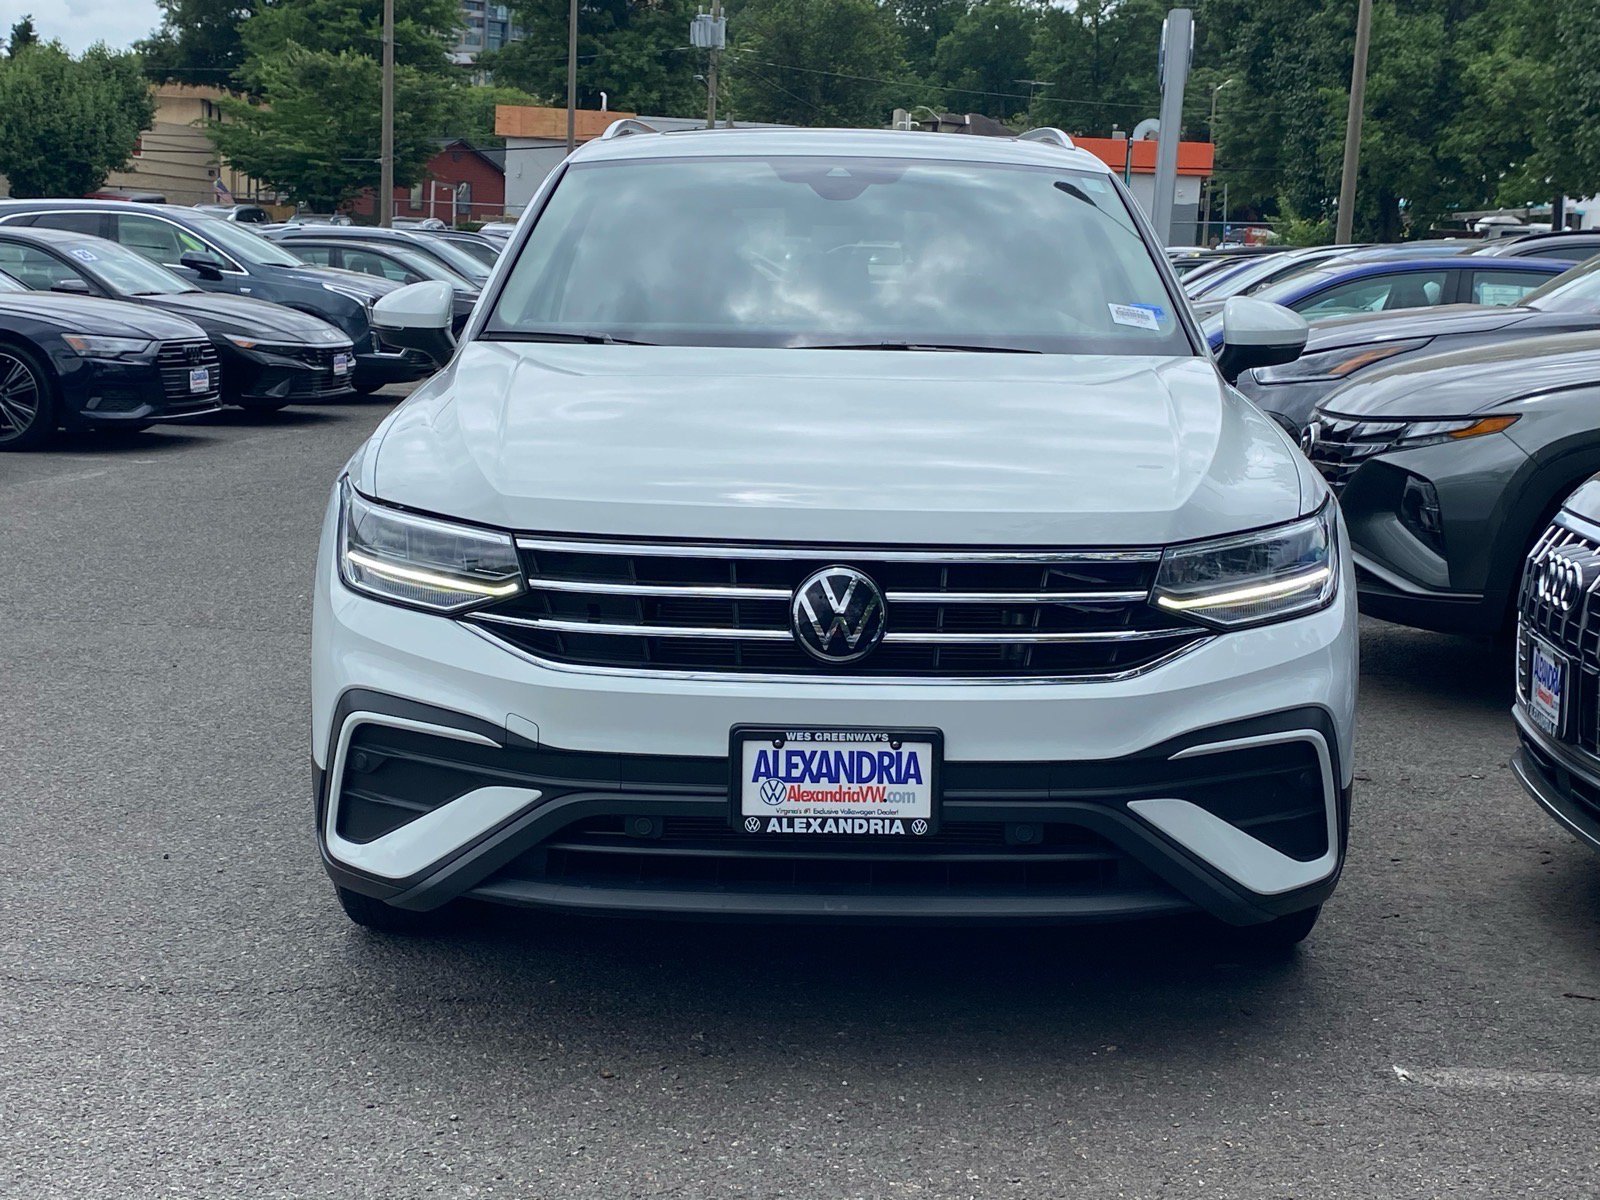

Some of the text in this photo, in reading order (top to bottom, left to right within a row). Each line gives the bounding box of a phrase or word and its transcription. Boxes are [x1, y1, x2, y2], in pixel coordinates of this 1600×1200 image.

[786, 732, 889, 742] WES GREENWAY'S
[752, 750, 923, 785] ALEXANDRIA
[787, 785, 916, 803] AlexandriaVW.com
[766, 818, 905, 834] ALEXANDRIA
